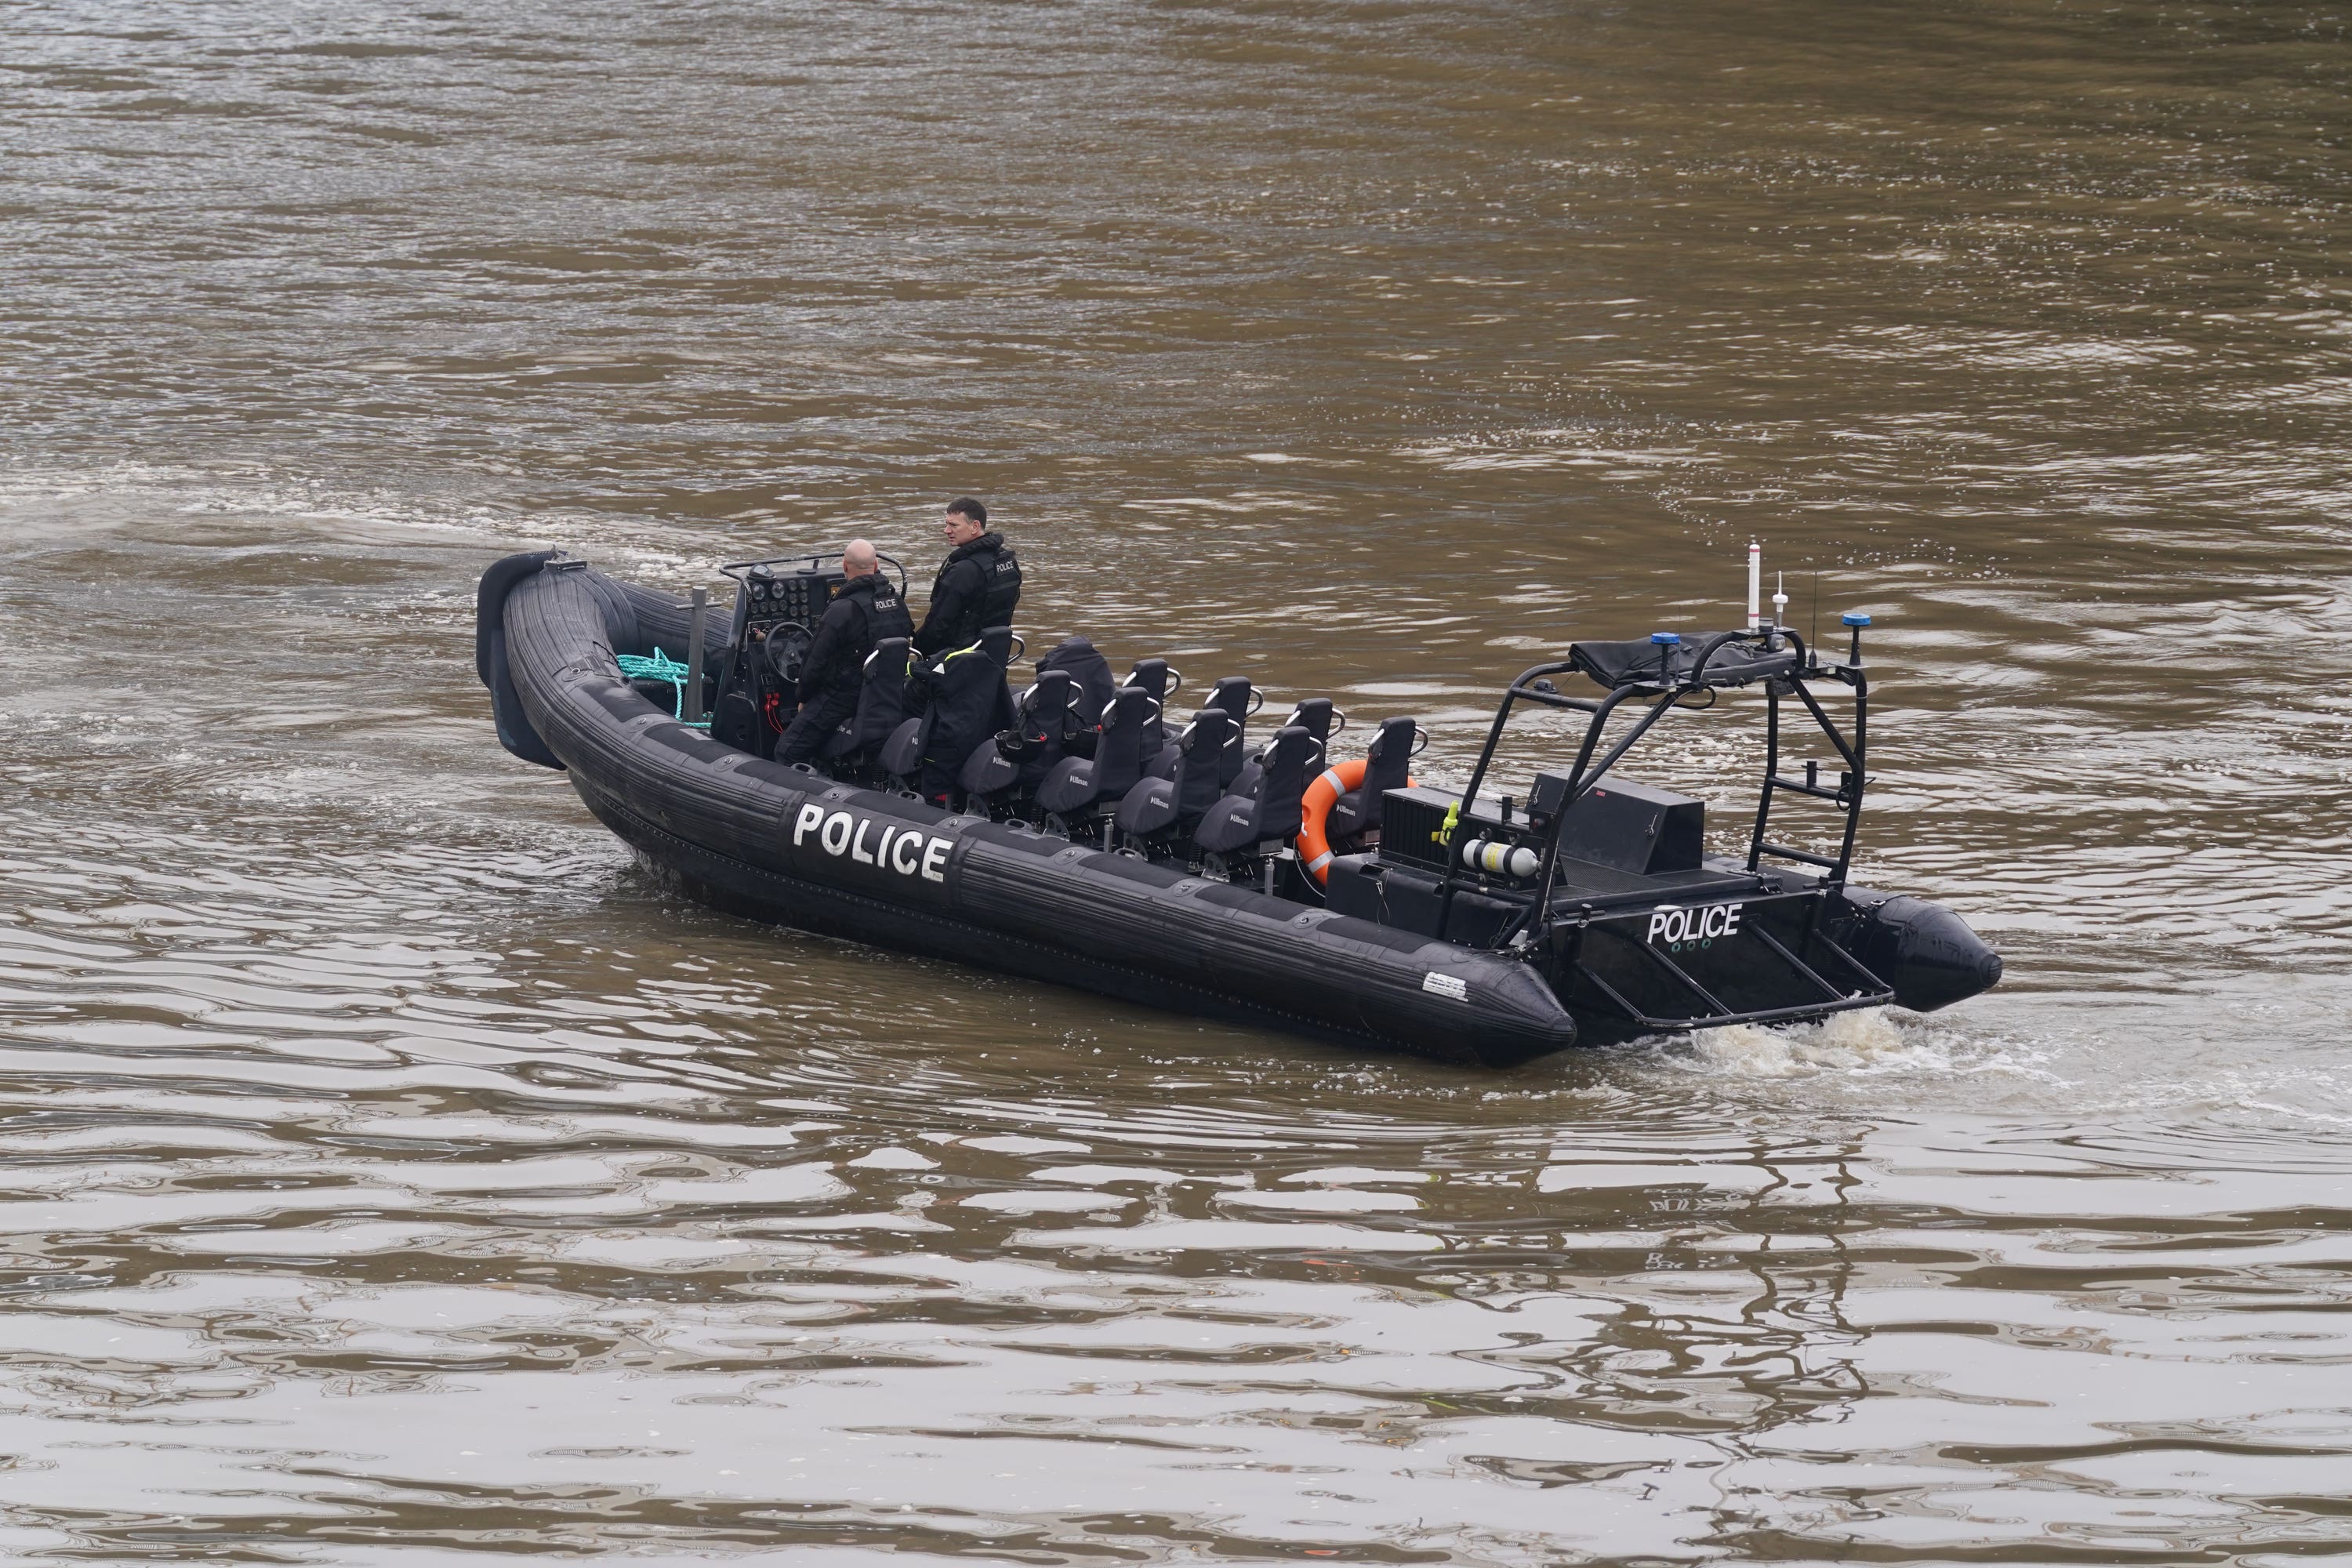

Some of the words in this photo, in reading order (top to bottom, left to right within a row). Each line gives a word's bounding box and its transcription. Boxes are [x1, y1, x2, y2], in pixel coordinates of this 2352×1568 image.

[996, 560, 1014, 573] POLICE
[876, 598, 897, 609] POLICE
[996, 757, 1011, 768] Ullman
[1073, 775, 1088, 787] Ullman
[1153, 797, 1169, 809] Ullman
[1339, 804, 1356, 816] Ullman
[1233, 814, 1249, 826] Ullman
[793, 802, 954, 883] POLICE
[1646, 903, 1743, 945] POLICE
